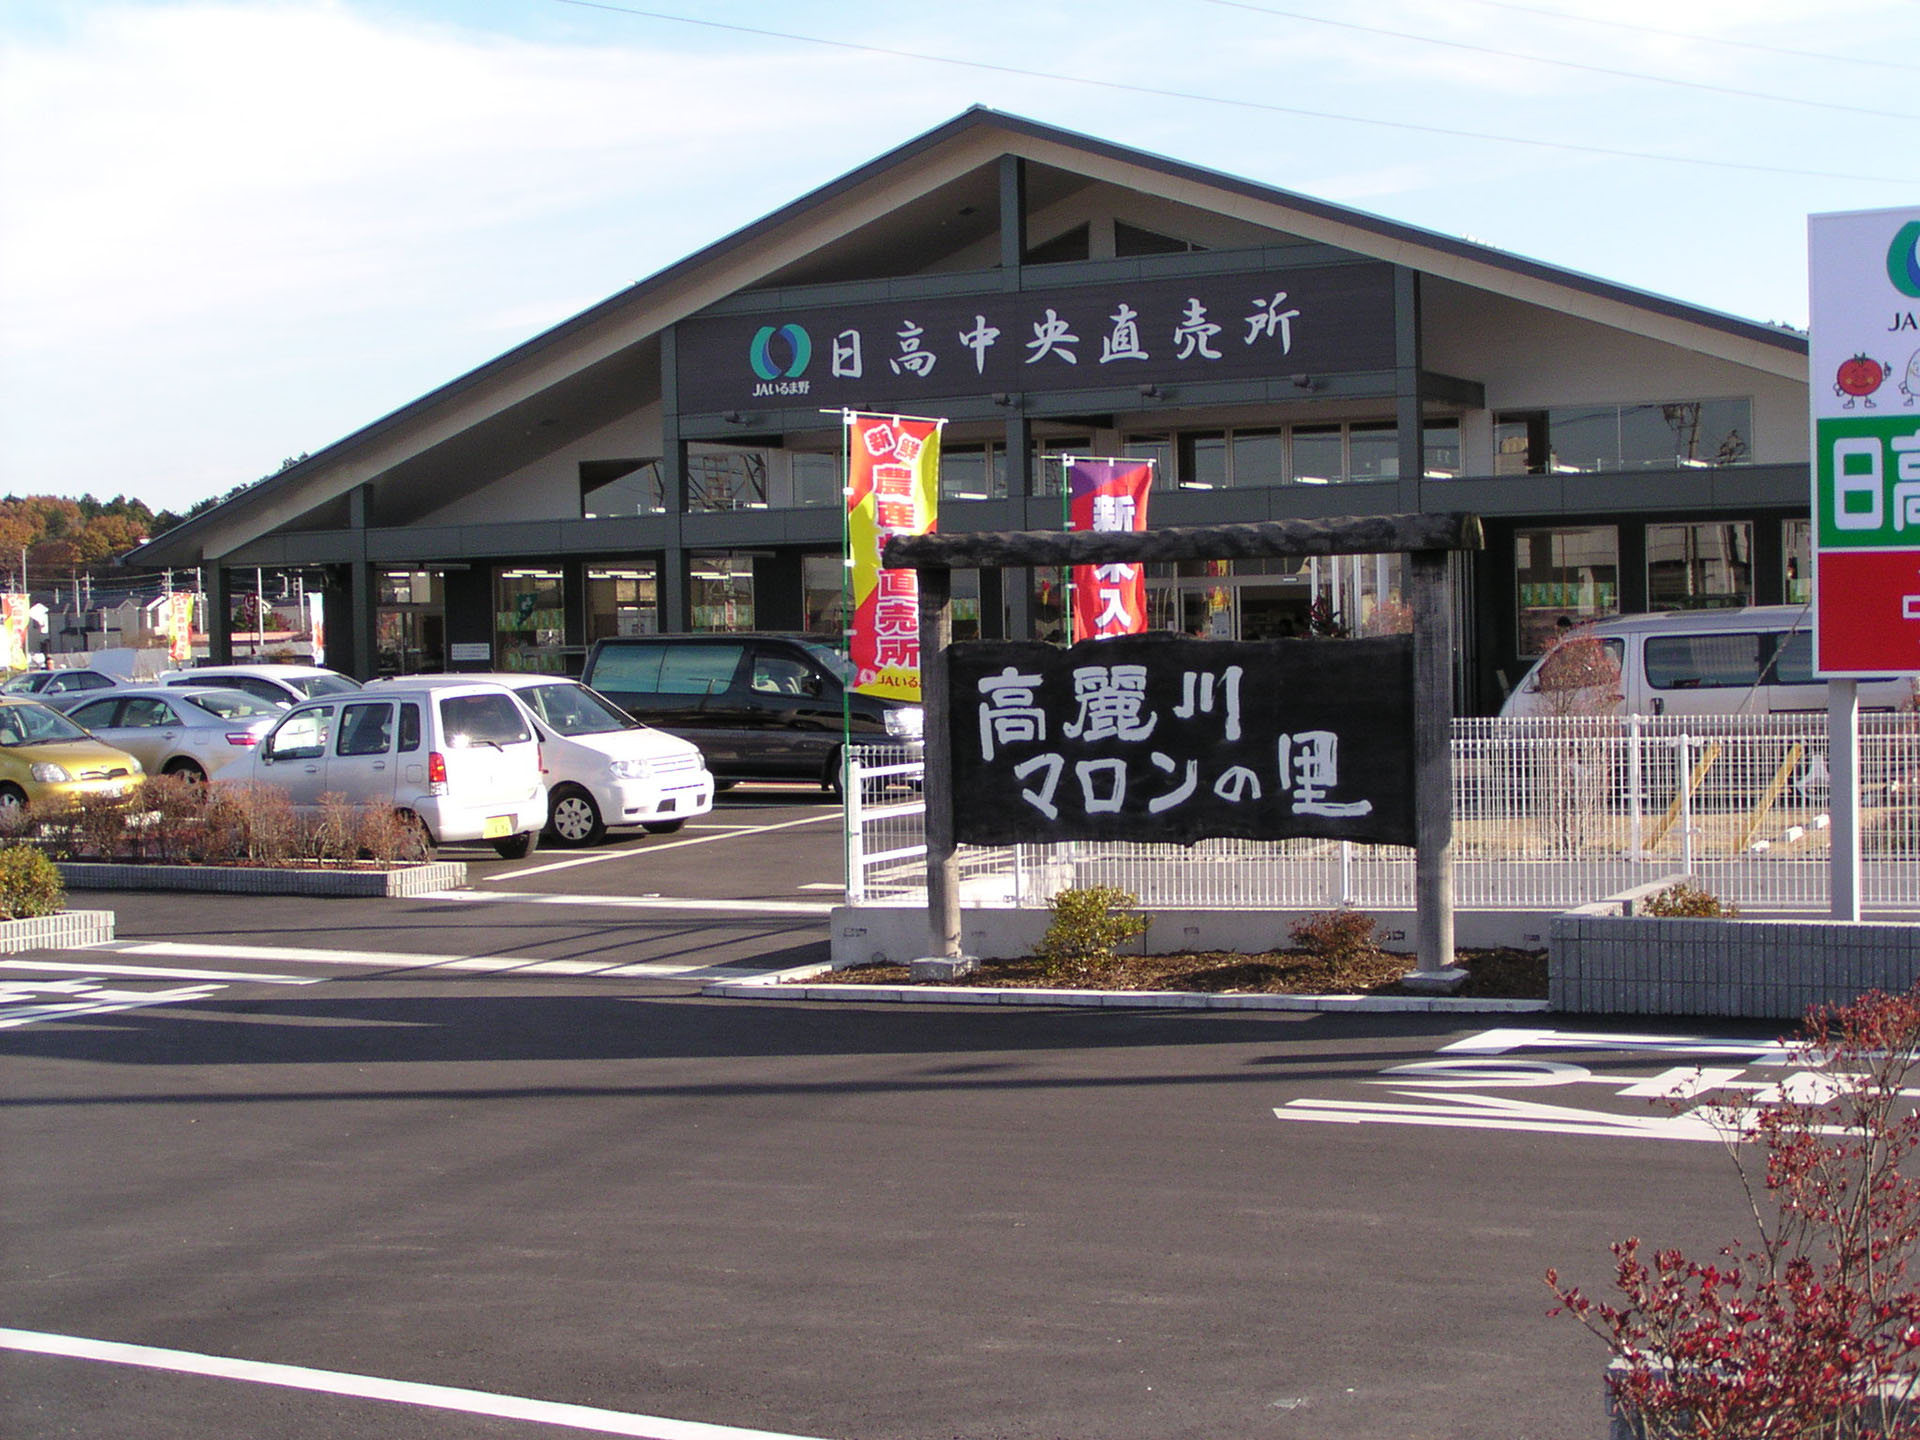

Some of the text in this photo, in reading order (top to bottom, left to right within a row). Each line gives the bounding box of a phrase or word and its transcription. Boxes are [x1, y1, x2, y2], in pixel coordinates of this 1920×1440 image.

[831, 292, 1300, 379] 日高中央直売所
[752, 381, 810, 397] JAいるま野
[1093, 495, 1136, 640] 新入
[878, 675, 922, 688] JAいる
[977, 665, 1243, 761] 高麗川
[1014, 730, 1372, 820] マロンの里
